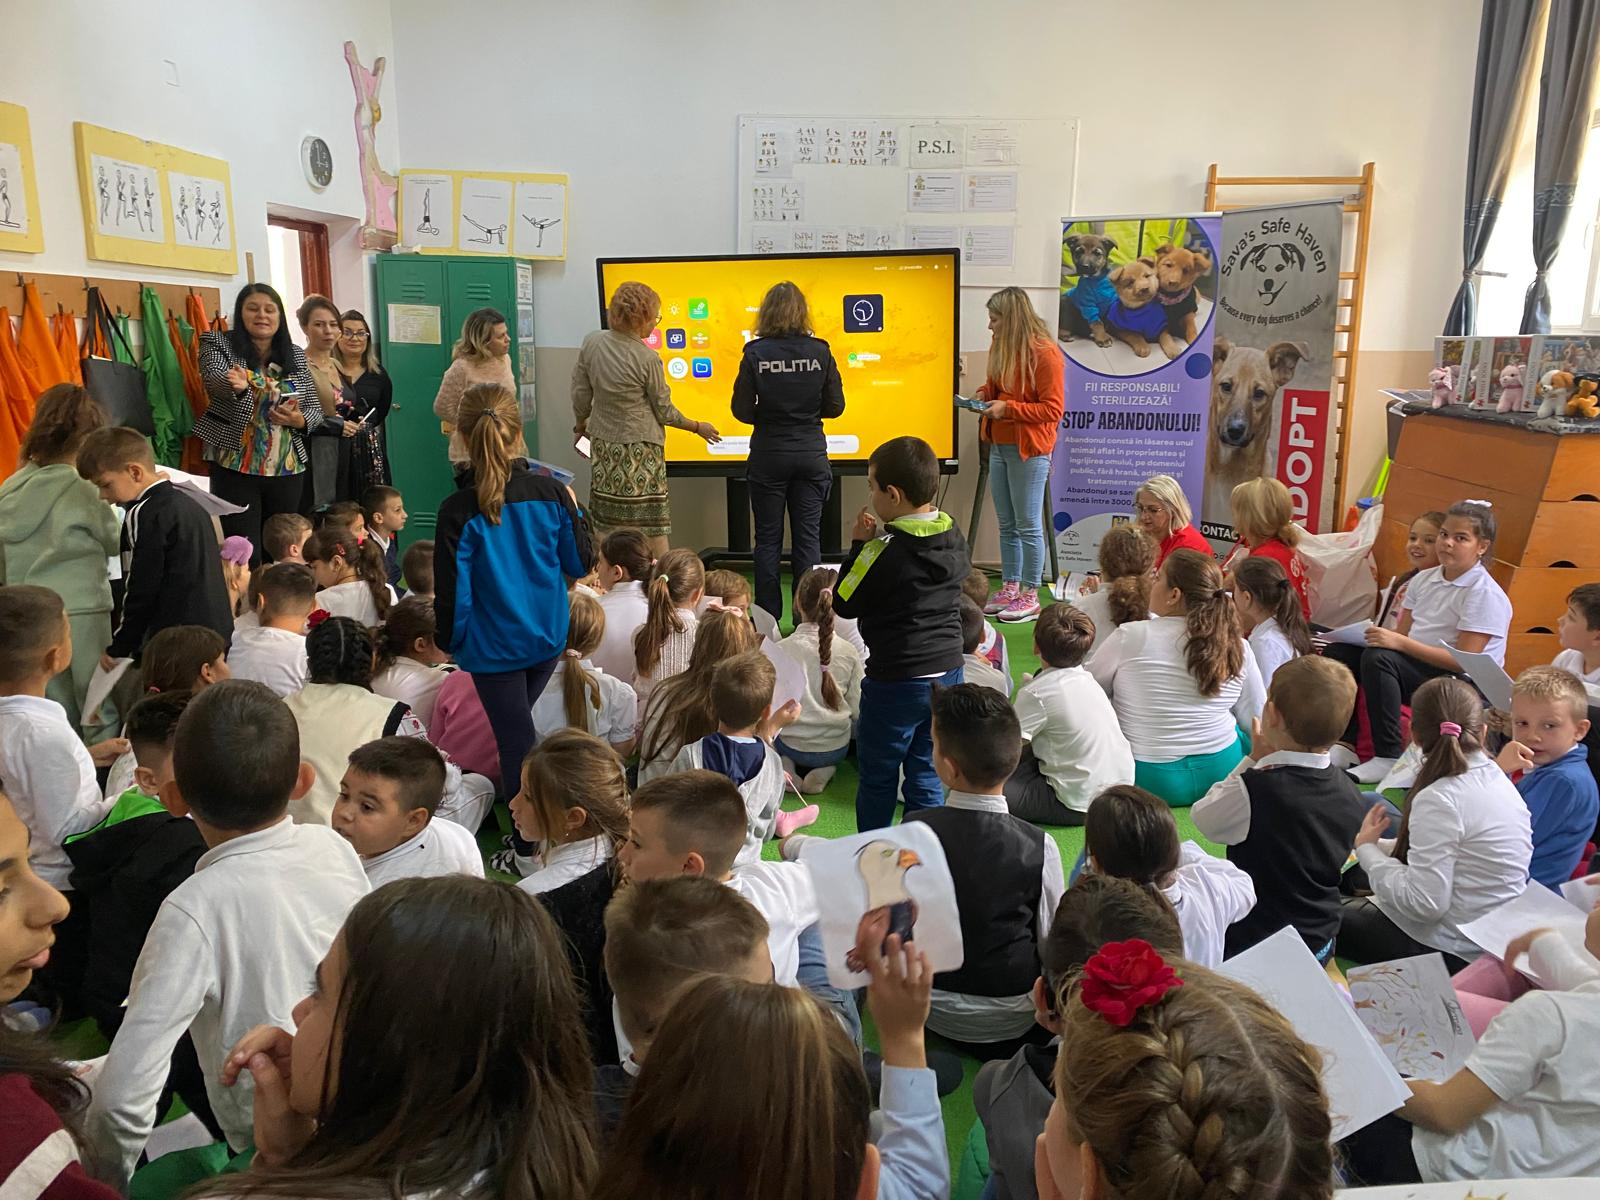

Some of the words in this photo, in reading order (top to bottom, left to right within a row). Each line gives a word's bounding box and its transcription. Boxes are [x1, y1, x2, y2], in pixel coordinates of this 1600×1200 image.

[918, 140, 956, 154] P.S.I.
[1221, 230, 1256, 276] Sava's
[1261, 217, 1291, 235] Safe
[1295, 222, 1327, 274] Haven
[1239, 312, 1256, 325] every
[1257, 314, 1267, 326] dog
[1269, 313, 1295, 324] deserves
[758, 358, 822, 374] POLITIA
[1085, 382, 1098, 392] FII
[1101, 382, 1180, 393] RESPONSABIL!
[1091, 395, 1172, 406] STERILIZEAZĂ!
[1062, 411, 1095, 430] STOP
[1065, 436, 1106, 444] Abandonul
[1107, 437, 1134, 445] constă
[1144, 438, 1174, 446] lăsarea
[1175, 439, 1193, 447] unui
[1097, 447, 1115, 455] aflat
[1126, 448, 1178, 458] proprietatea
[1105, 459, 1134, 467] omului,
[1135, 460, 1146, 468] pe
[1147, 459, 1186, 468] domeniul
[1287, 397, 1317, 530] DOPT
[1097, 468, 1114, 476] fără
[1087, 478, 1127, 487] tratament
[1067, 487, 1108, 496] Abandonul
[1060, 497, 1090, 505] amendă
[1200, 524, 1239, 541] ONTAC
